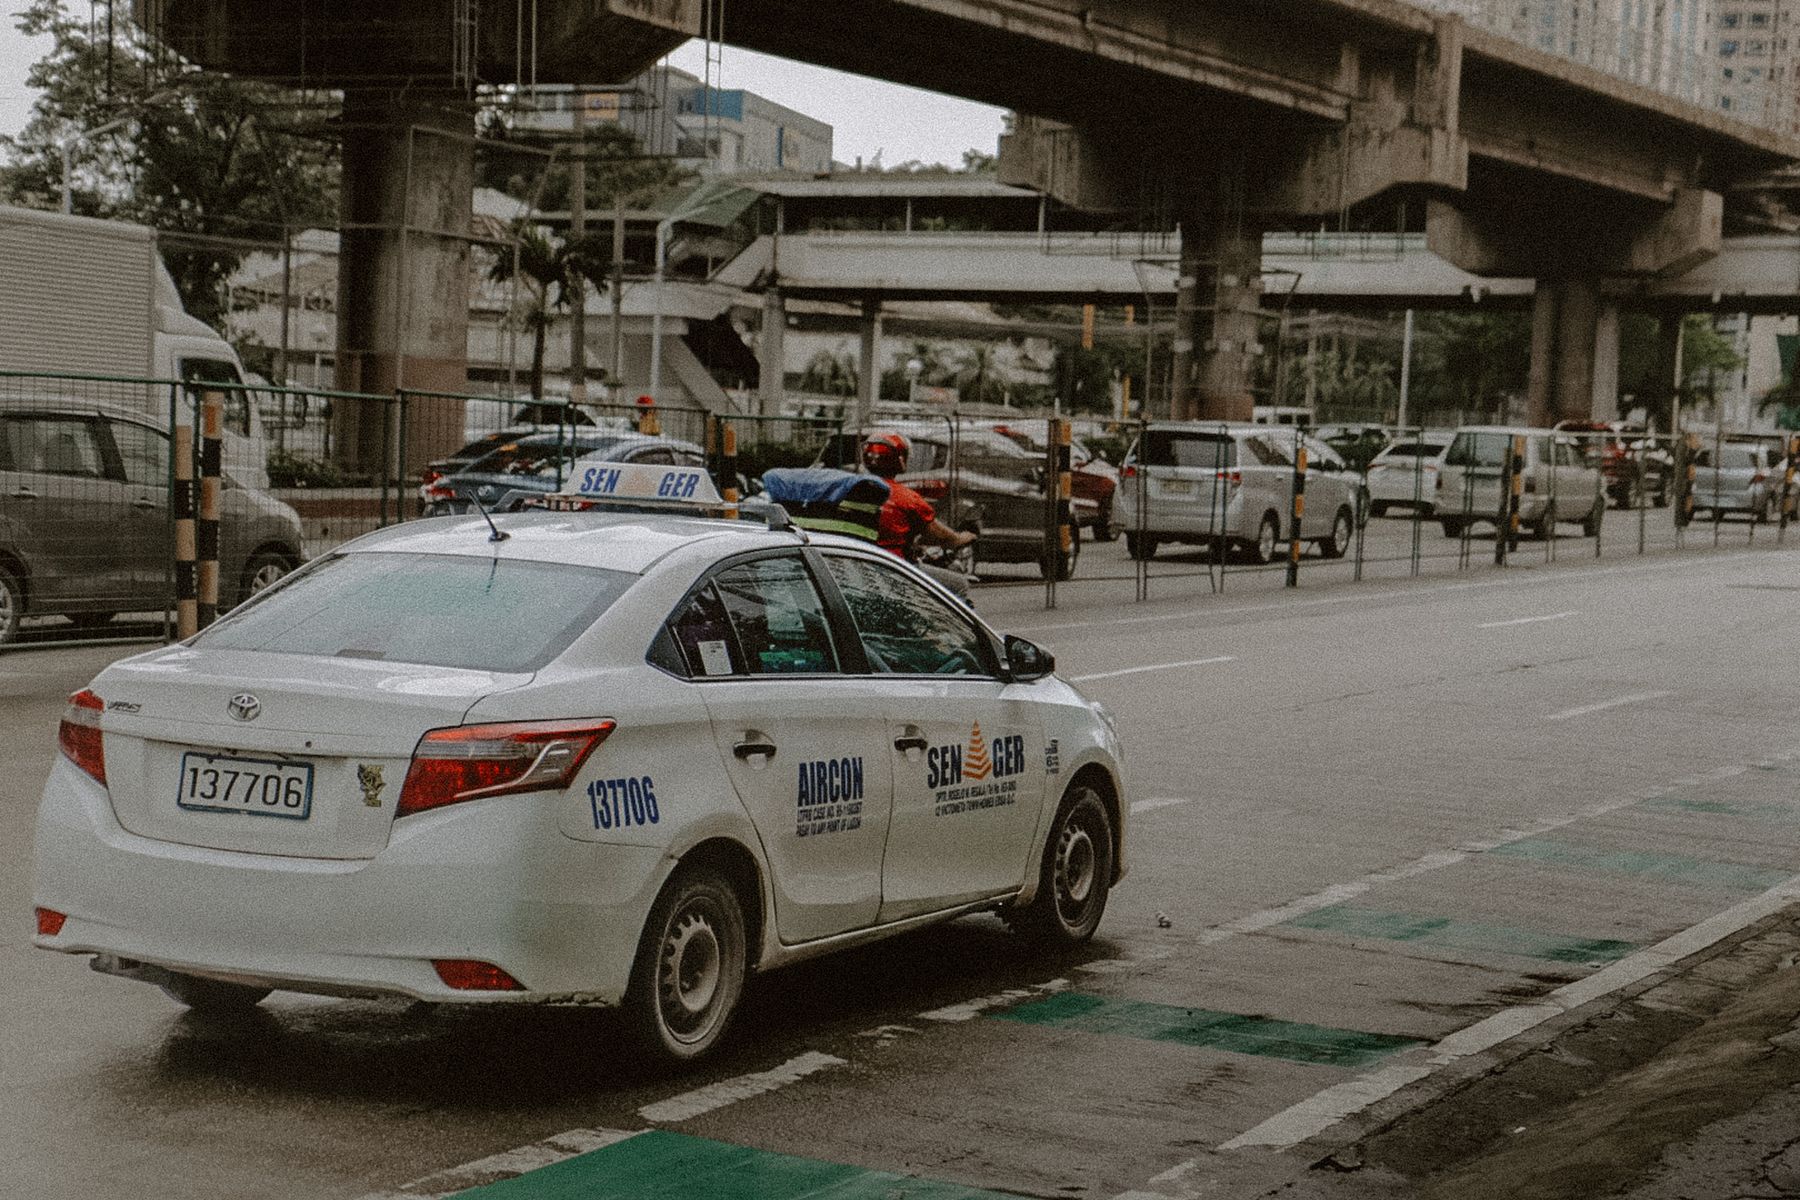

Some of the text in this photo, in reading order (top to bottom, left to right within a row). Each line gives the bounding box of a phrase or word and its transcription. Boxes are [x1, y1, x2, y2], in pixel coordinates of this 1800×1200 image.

[580, 468, 700, 497] SEN GER
[797, 757, 863, 807] AIRCON
[927, 744, 962, 789] SEN
[992, 735, 1025, 778] GER
[189, 767, 302, 808] 137706
[587, 775, 660, 830] 137706
